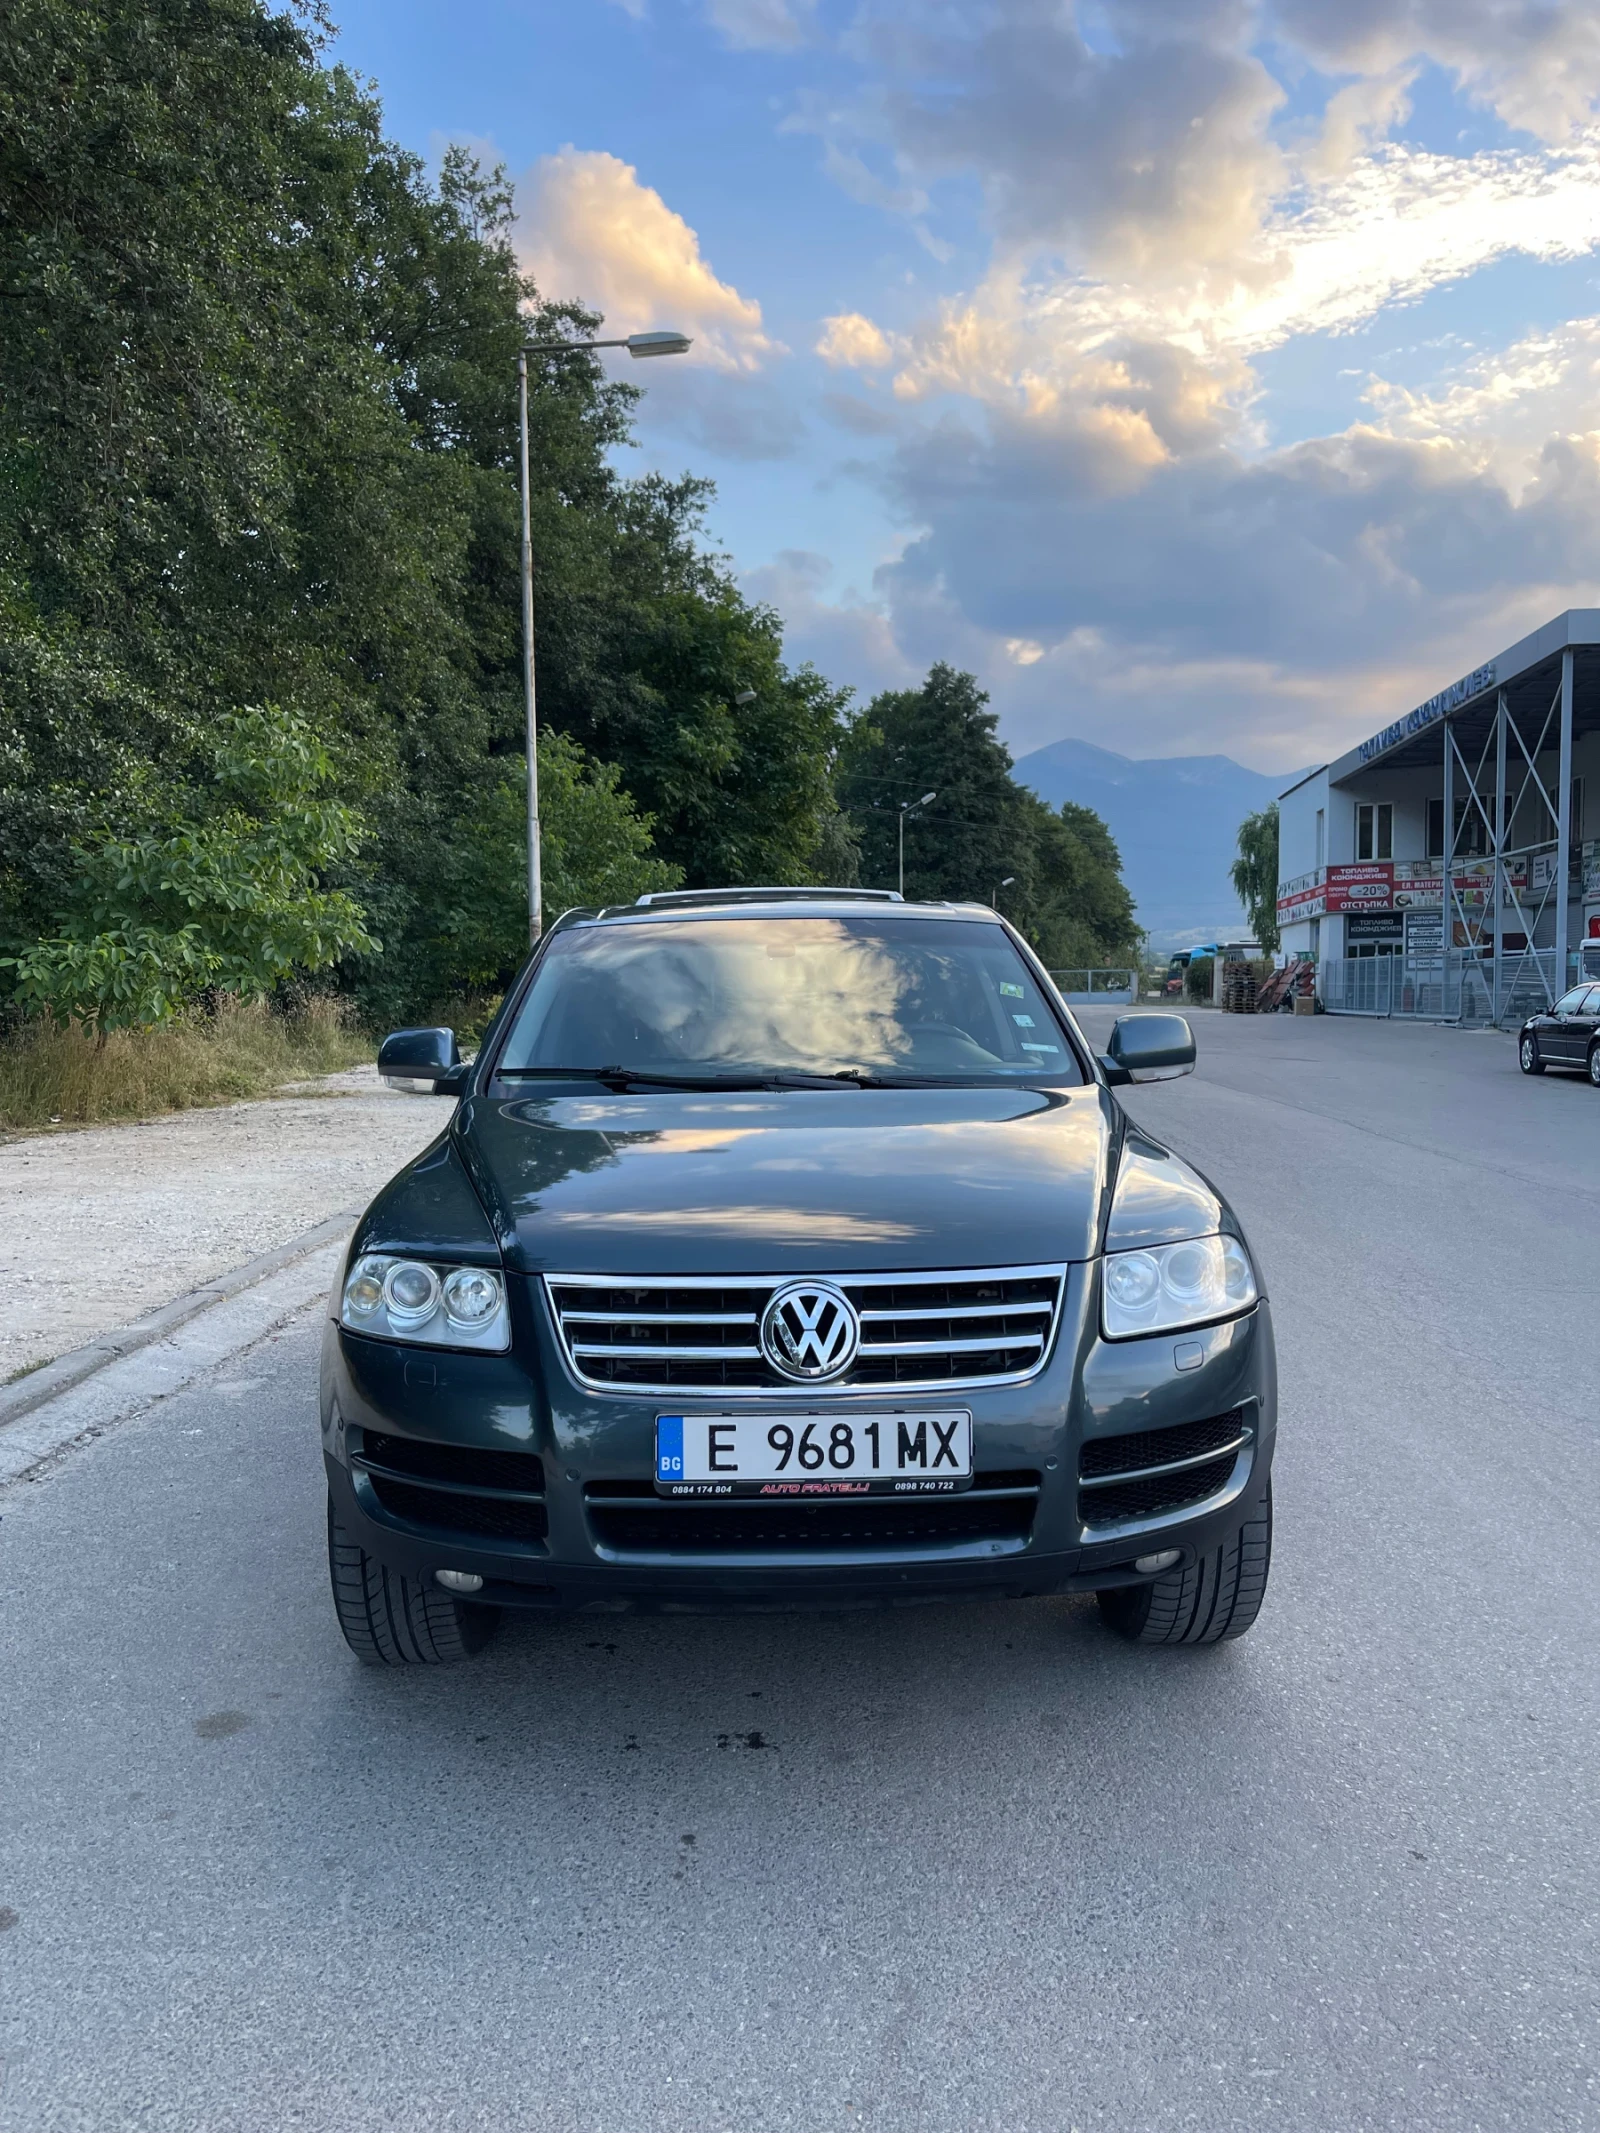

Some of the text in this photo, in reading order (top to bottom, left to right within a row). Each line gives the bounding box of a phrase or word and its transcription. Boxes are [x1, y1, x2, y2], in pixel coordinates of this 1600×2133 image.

[1331, 873, 1388, 881] КОЮМДЖИЕВ
[1357, 886, 1388, 896] -20%
[1340, 901, 1389, 909] ОТСТЪПКА
[1350, 925, 1402, 933] КОЮМДЖИЕВ
[708, 1420, 960, 1471] E 9681 MX
[661, 1456, 681, 1471] BG
[672, 1484, 732, 1494] 0884 174 804
[760, 1482, 870, 1494] AUTO FRATELLI
[895, 1481, 955, 1491] 0898 740 722
